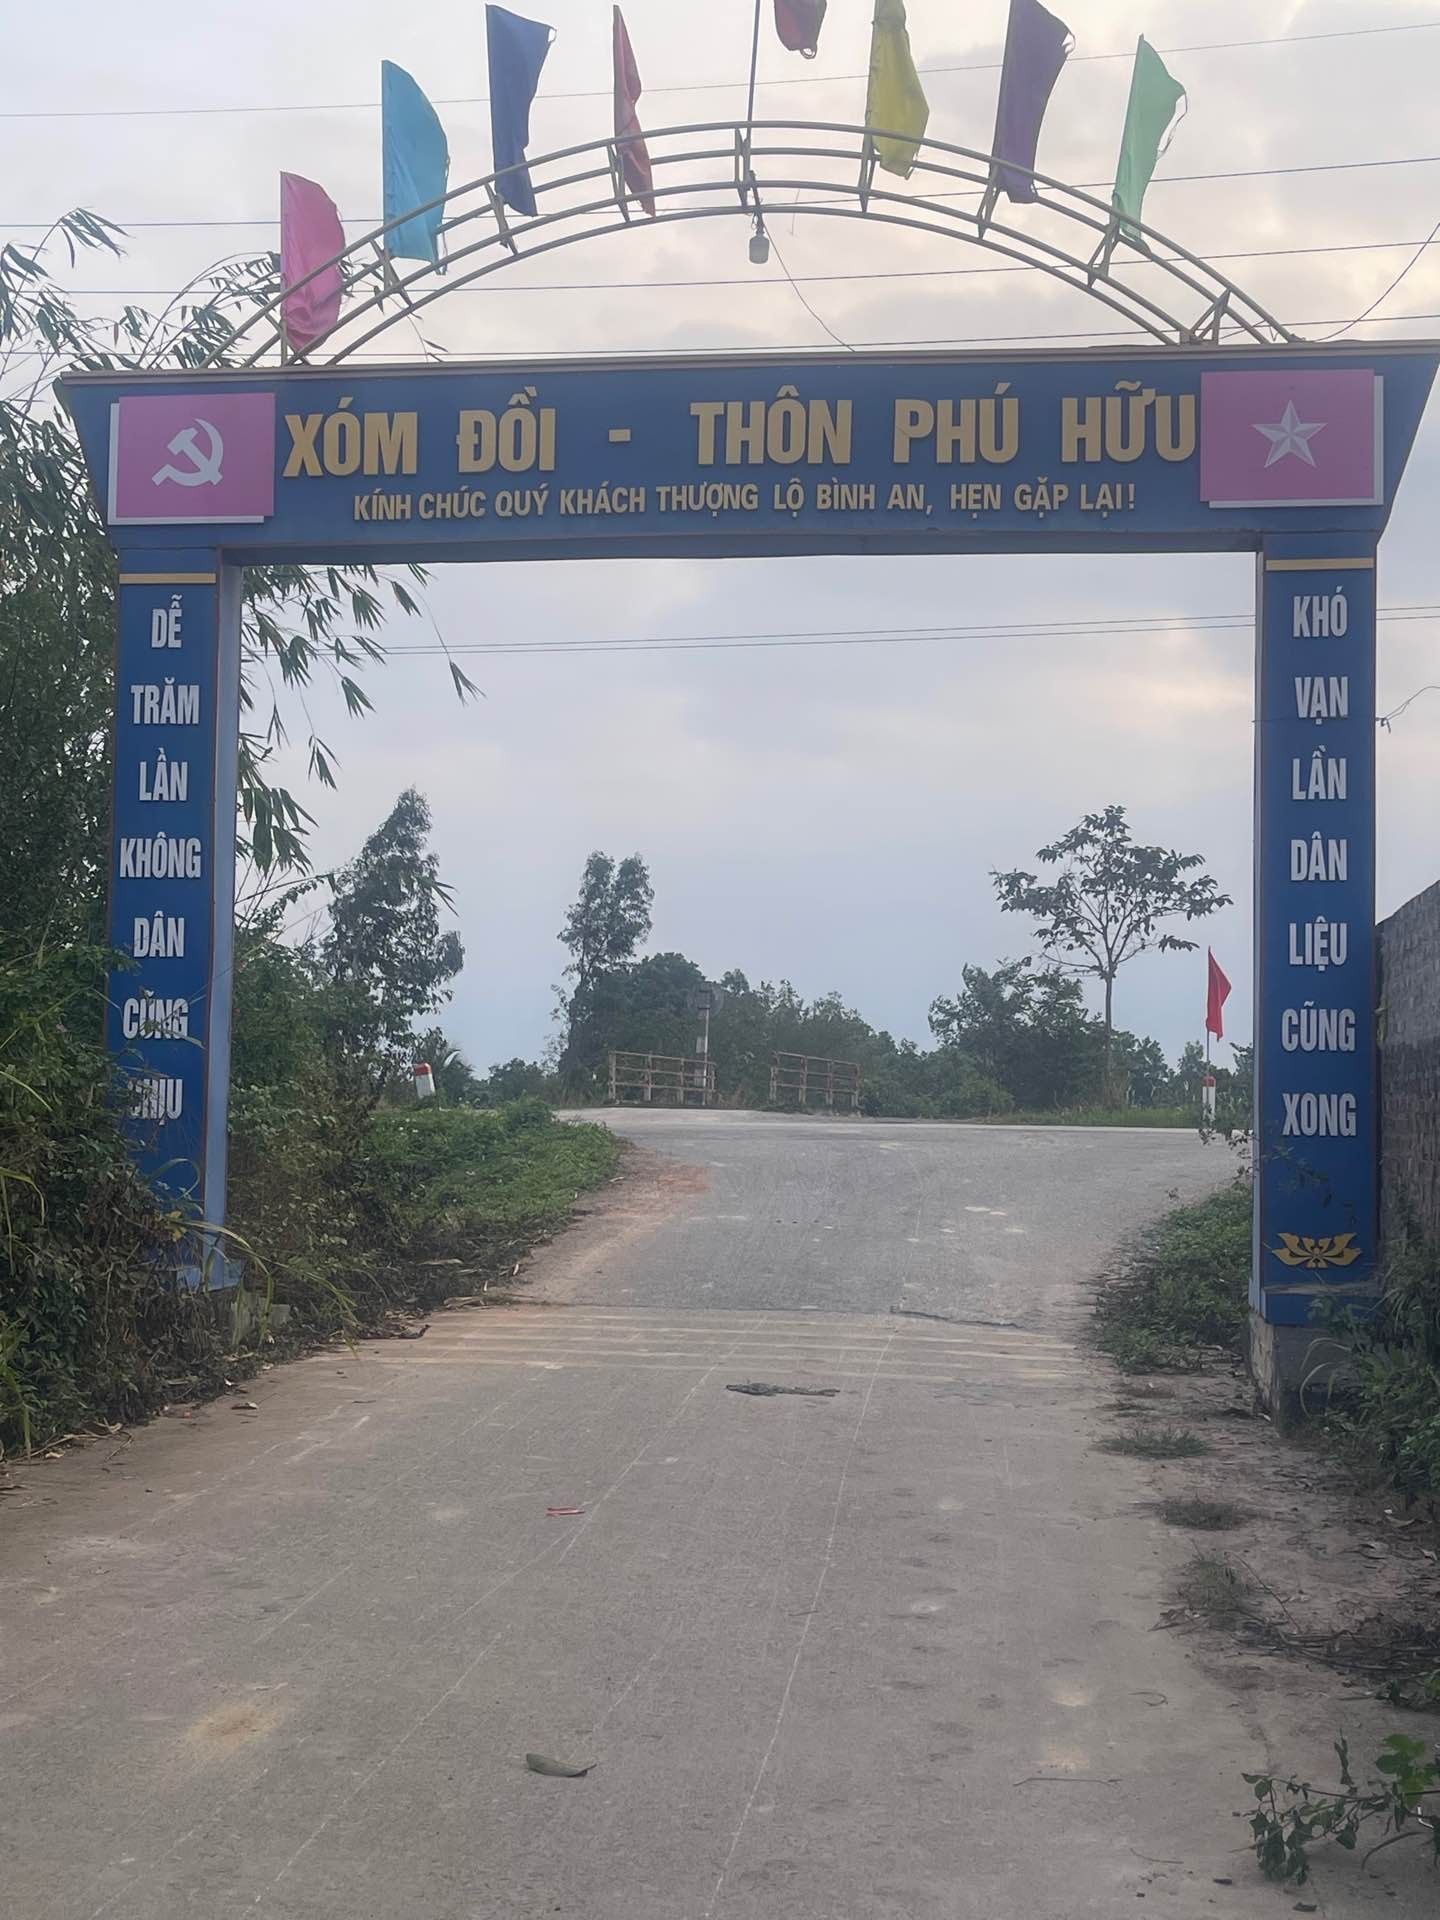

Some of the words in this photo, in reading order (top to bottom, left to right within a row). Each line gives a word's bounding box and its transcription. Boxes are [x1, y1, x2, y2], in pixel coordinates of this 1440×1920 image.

[282, 396, 418, 478] XÓM
[456, 386, 556, 473] ĐỒI
[608, 429, 632, 442] -
[690, 384, 853, 465] THÔN
[893, 382, 1019, 464] PHÚ
[1061, 380, 1196, 463] HỮU
[354, 488, 412, 521] KÍNH
[419, 485, 487, 520] CHÚC
[495, 483, 549, 518] QUÝ
[559, 480, 646, 515] KHÁCH
[656, 480, 759, 518] THƯỢNG
[773, 477, 805, 518] LỘ
[816, 476, 876, 511] BÌNH
[887, 483, 933, 516] AN,
[950, 483, 1001, 519] HẸN
[1014, 476, 1069, 519] GẶP
[1080, 483, 1135, 518] LẠI!
[151, 594, 183, 648] DỄ
[1293, 586, 1348, 637] KHÓ
[131, 676, 200, 725] TRĂM
[1294, 676, 1348, 725] VẠN
[139, 747, 188, 801] LẦN
[1291, 745, 1347, 800] LẦN
[119, 831, 201, 879] KHÔNG
[1290, 831, 1348, 881] DÂN
[133, 910, 185, 958] DÂN
[1289, 915, 1348, 971] LIỆU
[1281, 1001, 1355, 1051] CŨNG
[1282, 1093, 1357, 1136] XONG
